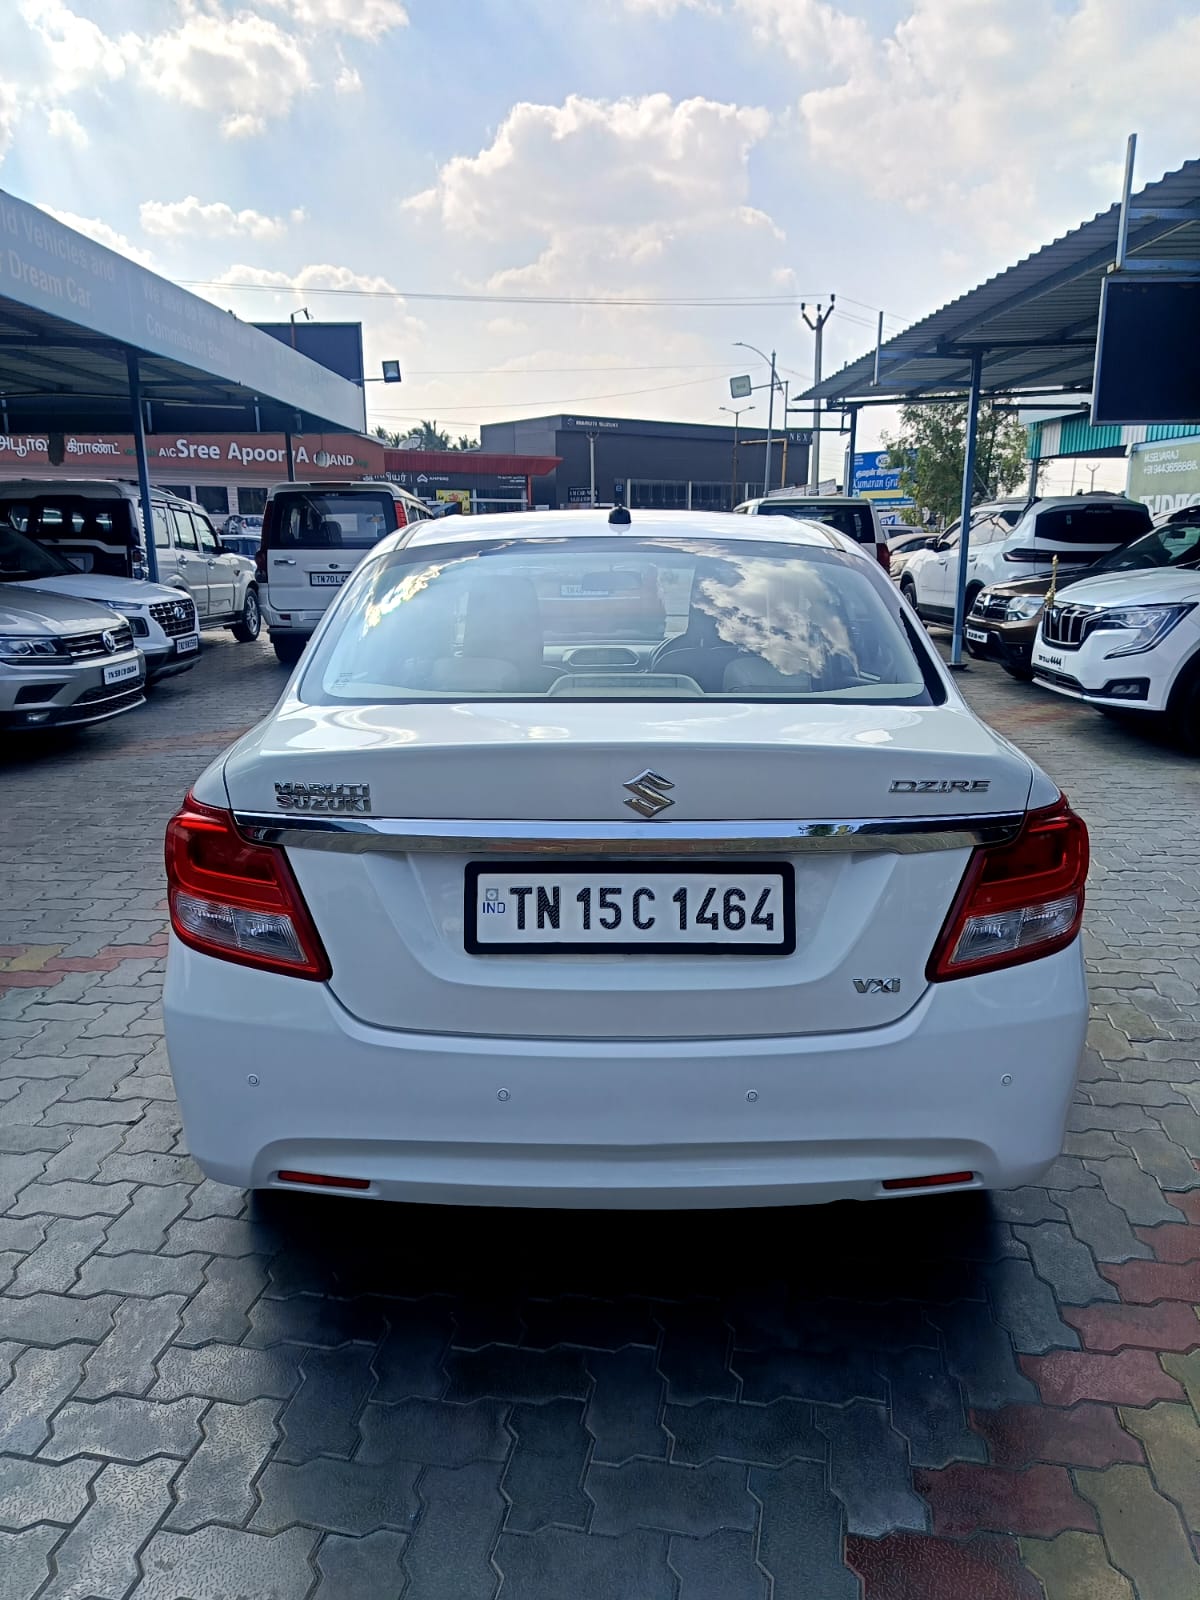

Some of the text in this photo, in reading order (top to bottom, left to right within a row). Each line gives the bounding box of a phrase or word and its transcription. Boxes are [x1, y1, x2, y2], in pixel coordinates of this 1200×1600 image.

[21, 211, 88, 270] Vehicles
[8, 248, 62, 298] Dream
[66, 276, 91, 310] Car
[176, 439, 221, 460] Sree
[227, 442, 309, 465] ApoorA
[274, 782, 370, 796] MARUTI
[888, 779, 992, 793] DZIRE
[276, 795, 372, 813] SUZUKI
[482, 901, 506, 914] IND
[510, 886, 560, 930] TN
[672, 887, 774, 931] 1464
